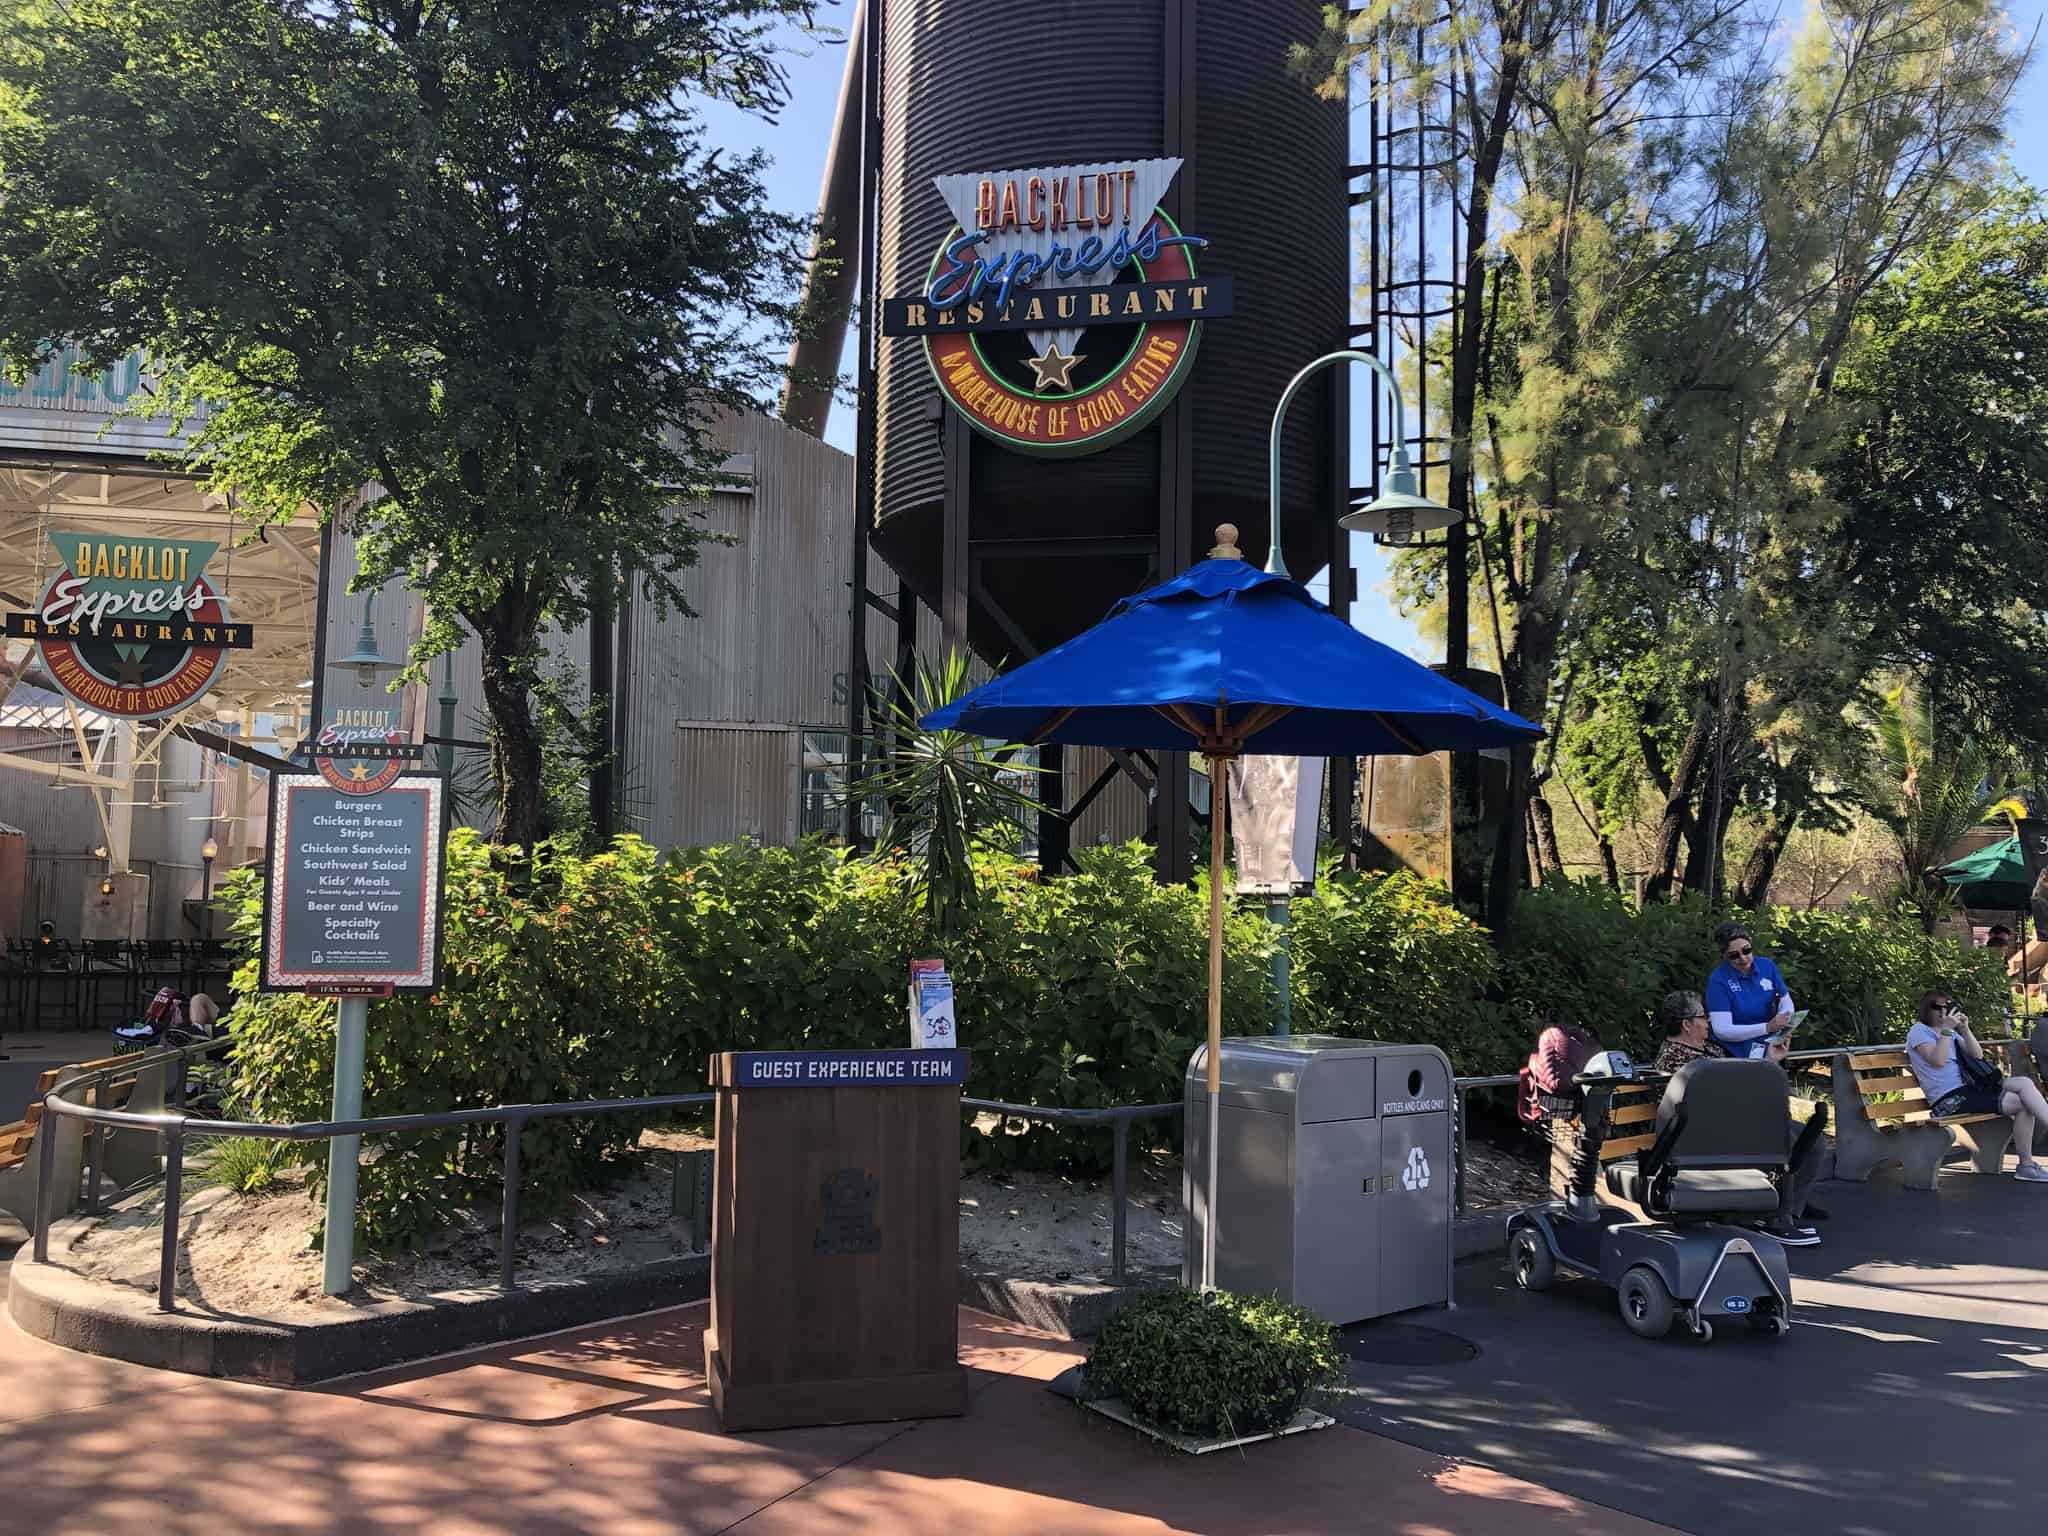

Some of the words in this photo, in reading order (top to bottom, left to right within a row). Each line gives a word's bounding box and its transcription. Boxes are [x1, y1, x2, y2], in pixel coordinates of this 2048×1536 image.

[975, 169, 1136, 233] BACKLOT
[928, 224, 1209, 313] Express
[948, 361, 1041, 435] WAREHOUSE
[1048, 406, 1069, 437] OF
[1077, 389, 1126, 432] GOOD
[1122, 336, 1178, 402] EATING
[76, 542, 189, 582] BACKLOT
[41, 577, 231, 633] Express
[47, 648, 68, 660] A
[180, 655, 215, 695] EATING
[55, 658, 123, 711] WAREHOUSE
[128, 691, 142, 712] OF
[146, 683, 180, 710] GOOD
[336, 709, 391, 728] BACKLOT
[320, 723, 409, 748] Express
[303, 745, 416, 757] RESTAURANT
[335, 800, 383, 813] Burgers
[313, 815, 360, 826] Chicken
[363, 816, 402, 827] Breast
[340, 828, 375, 840] Strips
[301, 843, 348, 854] Chicken
[351, 844, 411, 855] Sandwich
[303, 859, 368, 870] Southwest
[372, 860, 407, 871] Salad
[354, 876, 391, 887] Meals
[308, 901, 336, 911] Beer
[340, 901, 364, 911] and
[367, 901, 399, 911] Wine
[324, 917, 381, 930] Specialty
[324, 930, 380, 940] Cocktails
[752, 1061, 803, 1078] GUEST
[808, 1061, 905, 1078] EXPERIENCE
[911, 1060, 952, 1077] TEAM
[1383, 1103, 1404, 1113] BOTTLES
[1405, 1101, 1416, 1112] AND
